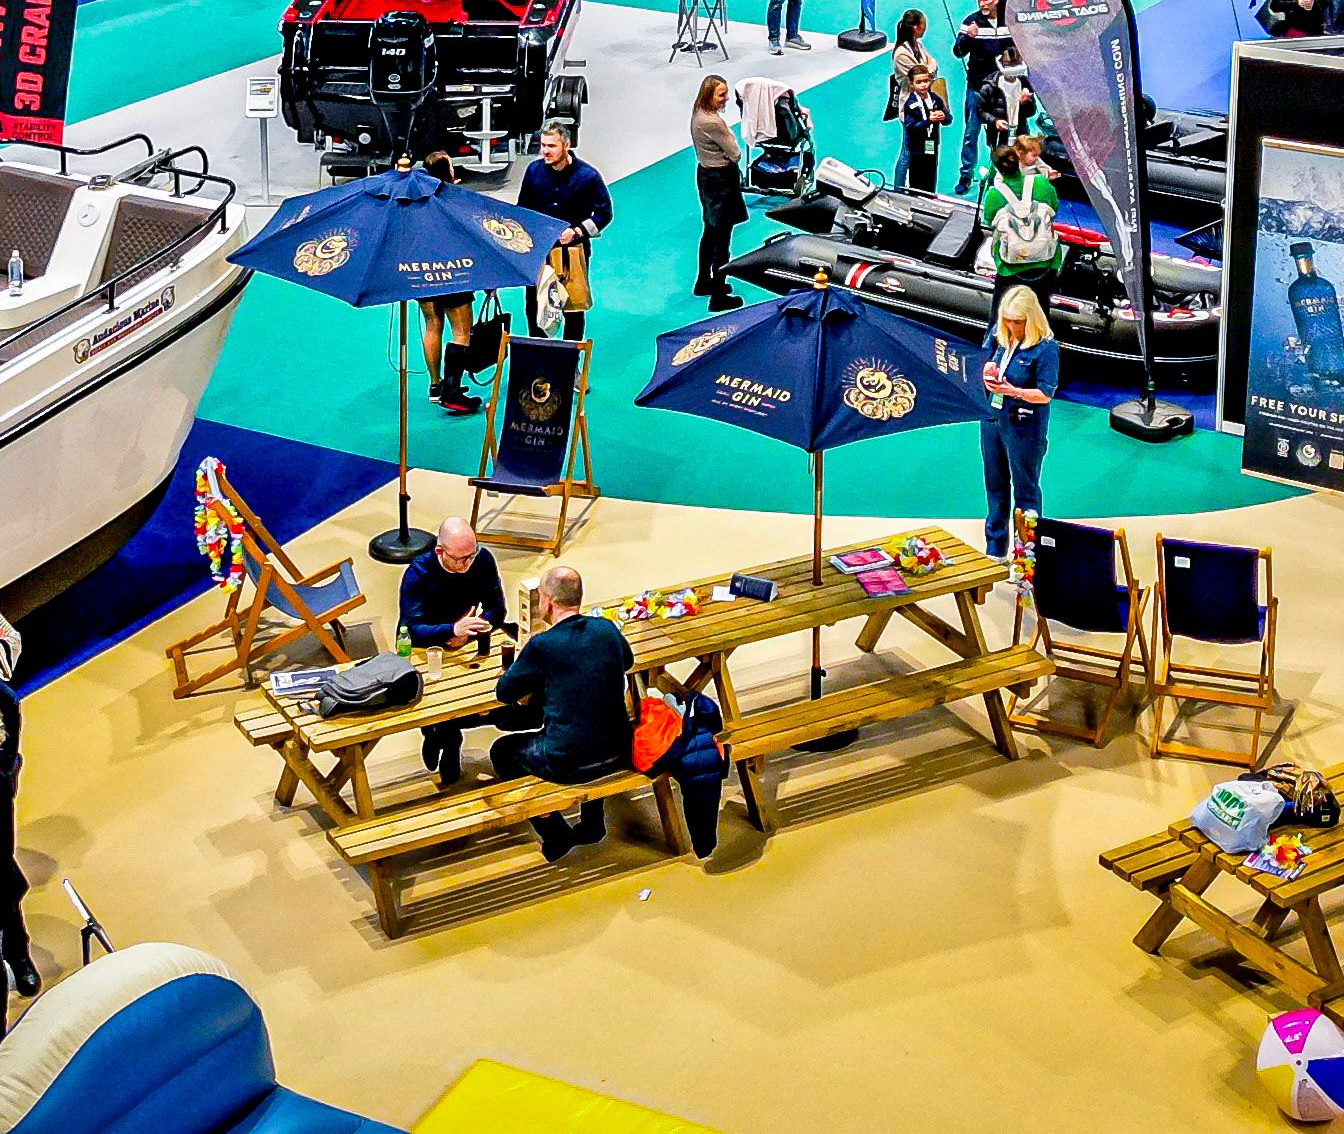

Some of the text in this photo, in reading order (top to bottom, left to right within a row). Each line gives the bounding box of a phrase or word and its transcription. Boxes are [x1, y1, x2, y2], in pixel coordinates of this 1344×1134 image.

[381, 47, 407, 57] 140
[13, 62, 43, 112] 3D
[398, 257, 474, 273] MERMAID
[423, 269, 454, 282] GIN
[715, 373, 793, 404] MERMAID
[731, 391, 763, 409] GIN
[1250, 395, 1286, 411] FREE
[1288, 402, 1328, 422] YOUR
[508, 420, 564, 437] MERMAID
[523, 434, 547, 447] GIN
